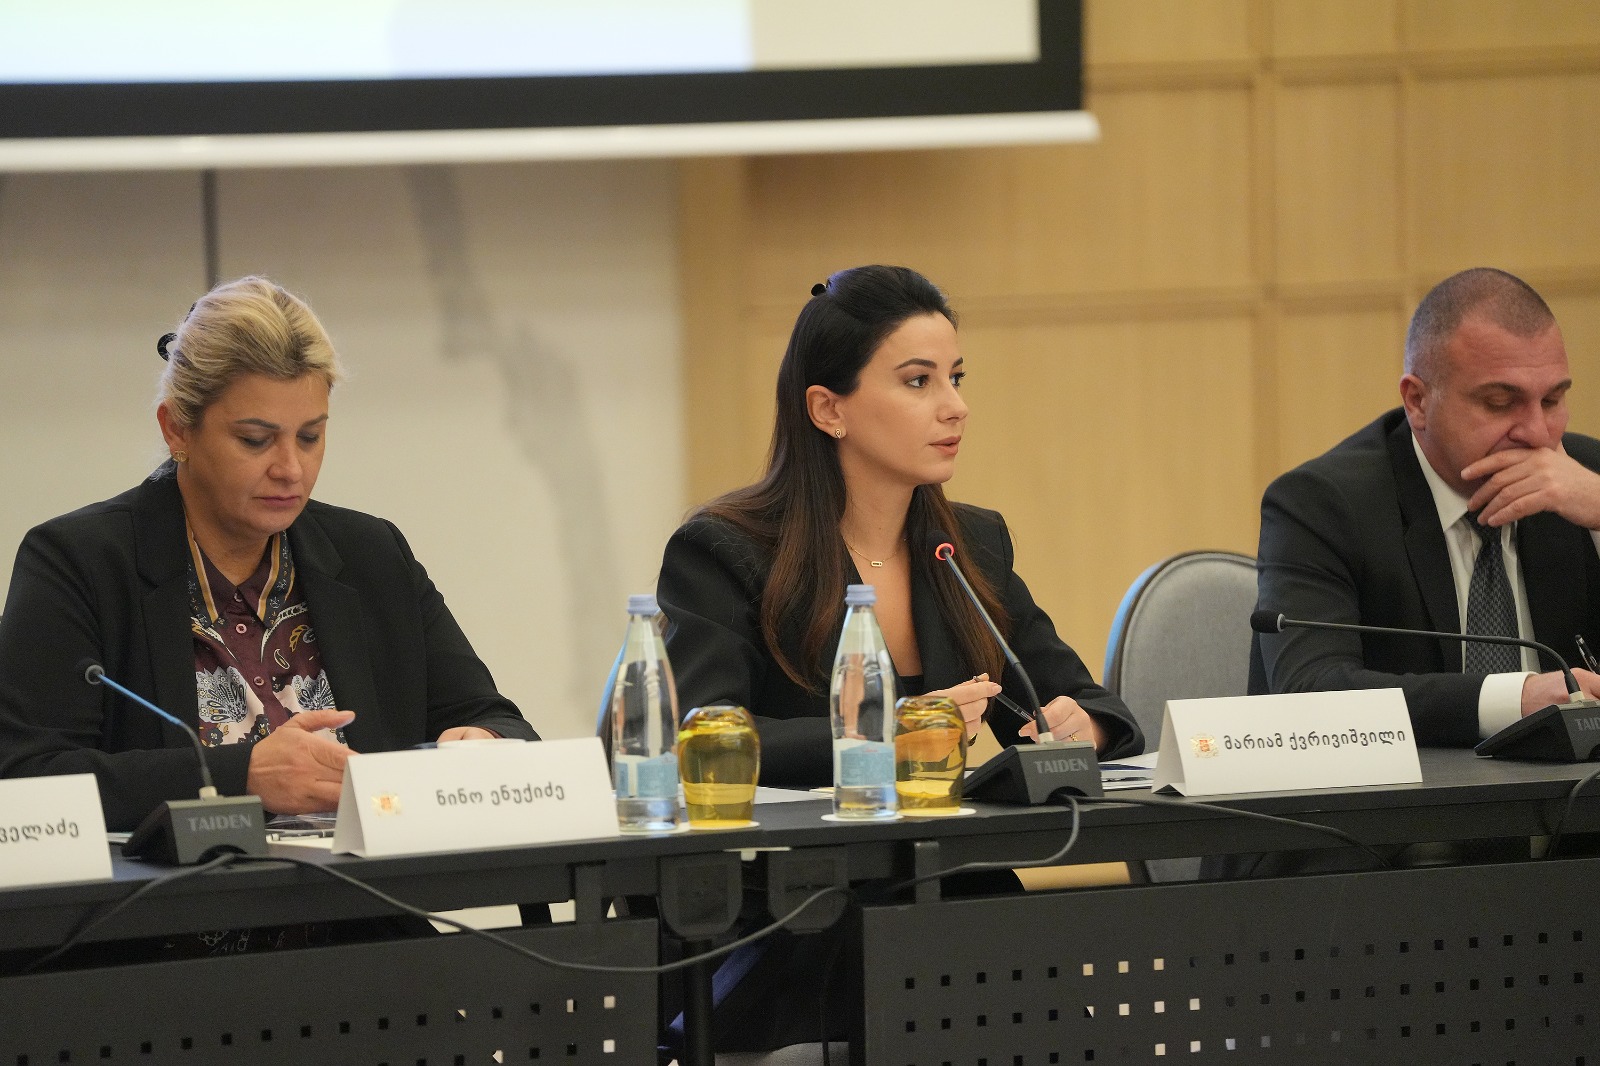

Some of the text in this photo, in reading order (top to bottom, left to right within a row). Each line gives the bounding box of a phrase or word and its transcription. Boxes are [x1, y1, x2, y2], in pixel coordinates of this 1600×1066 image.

[1223, 728, 1405, 750] მარიამ ქვრივიშვილი
[1035, 758, 1089, 773] TAIDEN
[436, 782, 564, 806] ნინო ენუქიძე
[188, 814, 252, 831] TAIDEN
